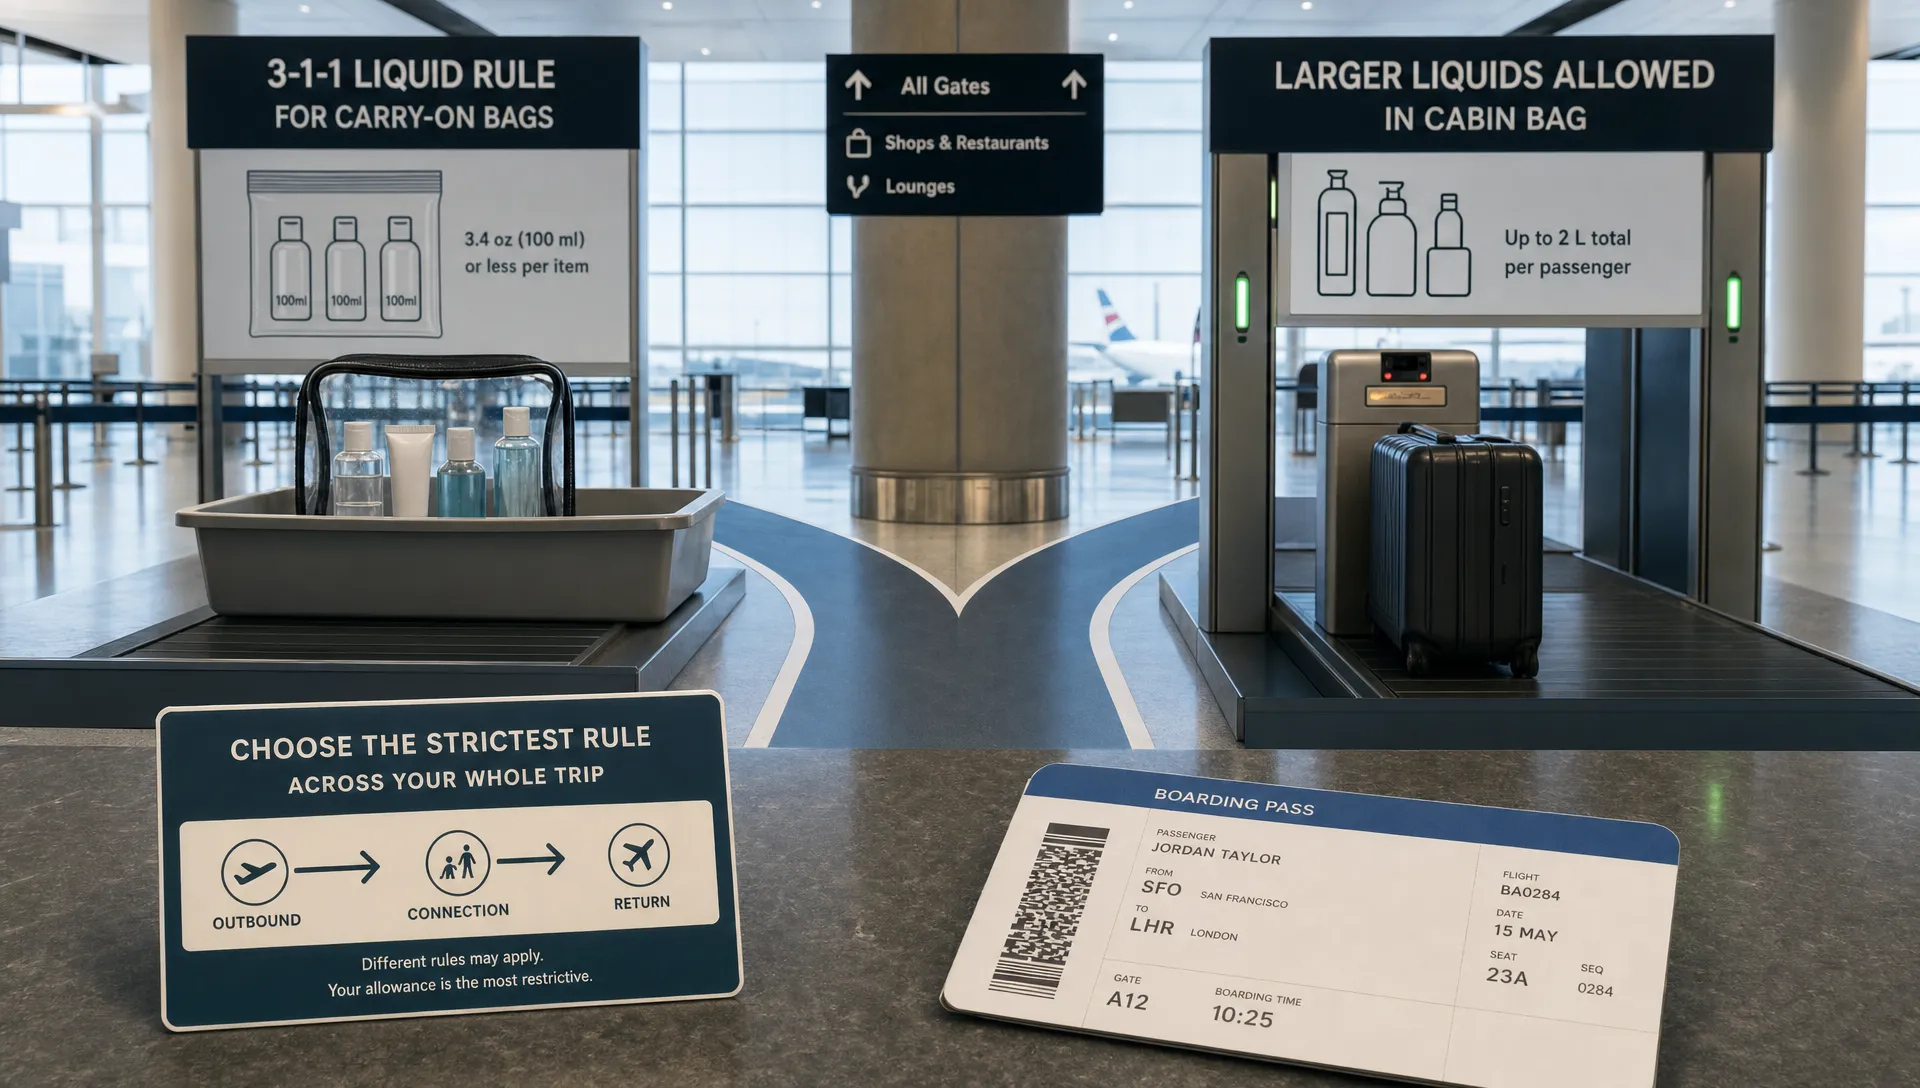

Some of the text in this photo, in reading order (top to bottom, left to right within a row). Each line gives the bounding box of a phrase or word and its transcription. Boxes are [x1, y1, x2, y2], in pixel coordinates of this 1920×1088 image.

[267, 57, 556, 92] 3-1-1 LIQUID RULE
[1275, 59, 1715, 93] LARGER LIQUIDS ALLOWED
[900, 75, 991, 96] All Gates
[275, 104, 554, 130] FOR CARRY-ON BAGS
[1385, 105, 1587, 131] IN CABIN BAG
[885, 134, 1050, 154] Shops & Restaurants
[886, 177, 956, 198] Lounges
[464, 230, 585, 249] 3.4 oz (100 ml)
[1505, 228, 1631, 250] Up to 2 L total
[465, 257, 589, 278] or less per item
[1505, 262, 1632, 279] per passenger
[276, 294, 307, 306] 100ml
[331, 294, 362, 306] 100ml
[385, 294, 417, 307] 100ml
[230, 725, 651, 761] CHOOSE THE STRICTEST RULE
[288, 765, 604, 795] ACROSS YOUR WHOLE TRIP
[1154, 788, 1315, 816] BOARDING PASS
[1156, 828, 1217, 843] PASSENGER
[1151, 842, 1281, 866] JORDAN TAYLOR
[1145, 866, 1174, 877] FROM
[1502, 870, 1540, 882] FLIGHT
[1141, 879, 1182, 897] SFO
[1500, 884, 1561, 902] BA0284
[614, 895, 670, 910] RETURN
[1135, 904, 1149, 913] TO
[1200, 890, 1289, 909] SAN FRANCISCO
[212, 913, 302, 930] OUTBOUND
[407, 903, 509, 921] CONNECTION
[1496, 908, 1524, 920] DATE
[1129, 916, 1175, 936] LHR
[1190, 928, 1239, 942] LONDON
[1494, 924, 1558, 943] 15 MAY
[362, 948, 544, 971] Different rules may apply.
[1489, 950, 1518, 962] SEAT
[1113, 973, 1142, 985] GATE
[1486, 967, 1528, 987] 23A
[1580, 963, 1604, 976] SEQ
[327, 969, 593, 998] Your allowance is the most restrictive.
[1577, 982, 1614, 998] 0284
[1106, 990, 1149, 1011] A12
[1214, 987, 1302, 1007] BOARDING TIME
[1211, 1005, 1274, 1030] 10:25
